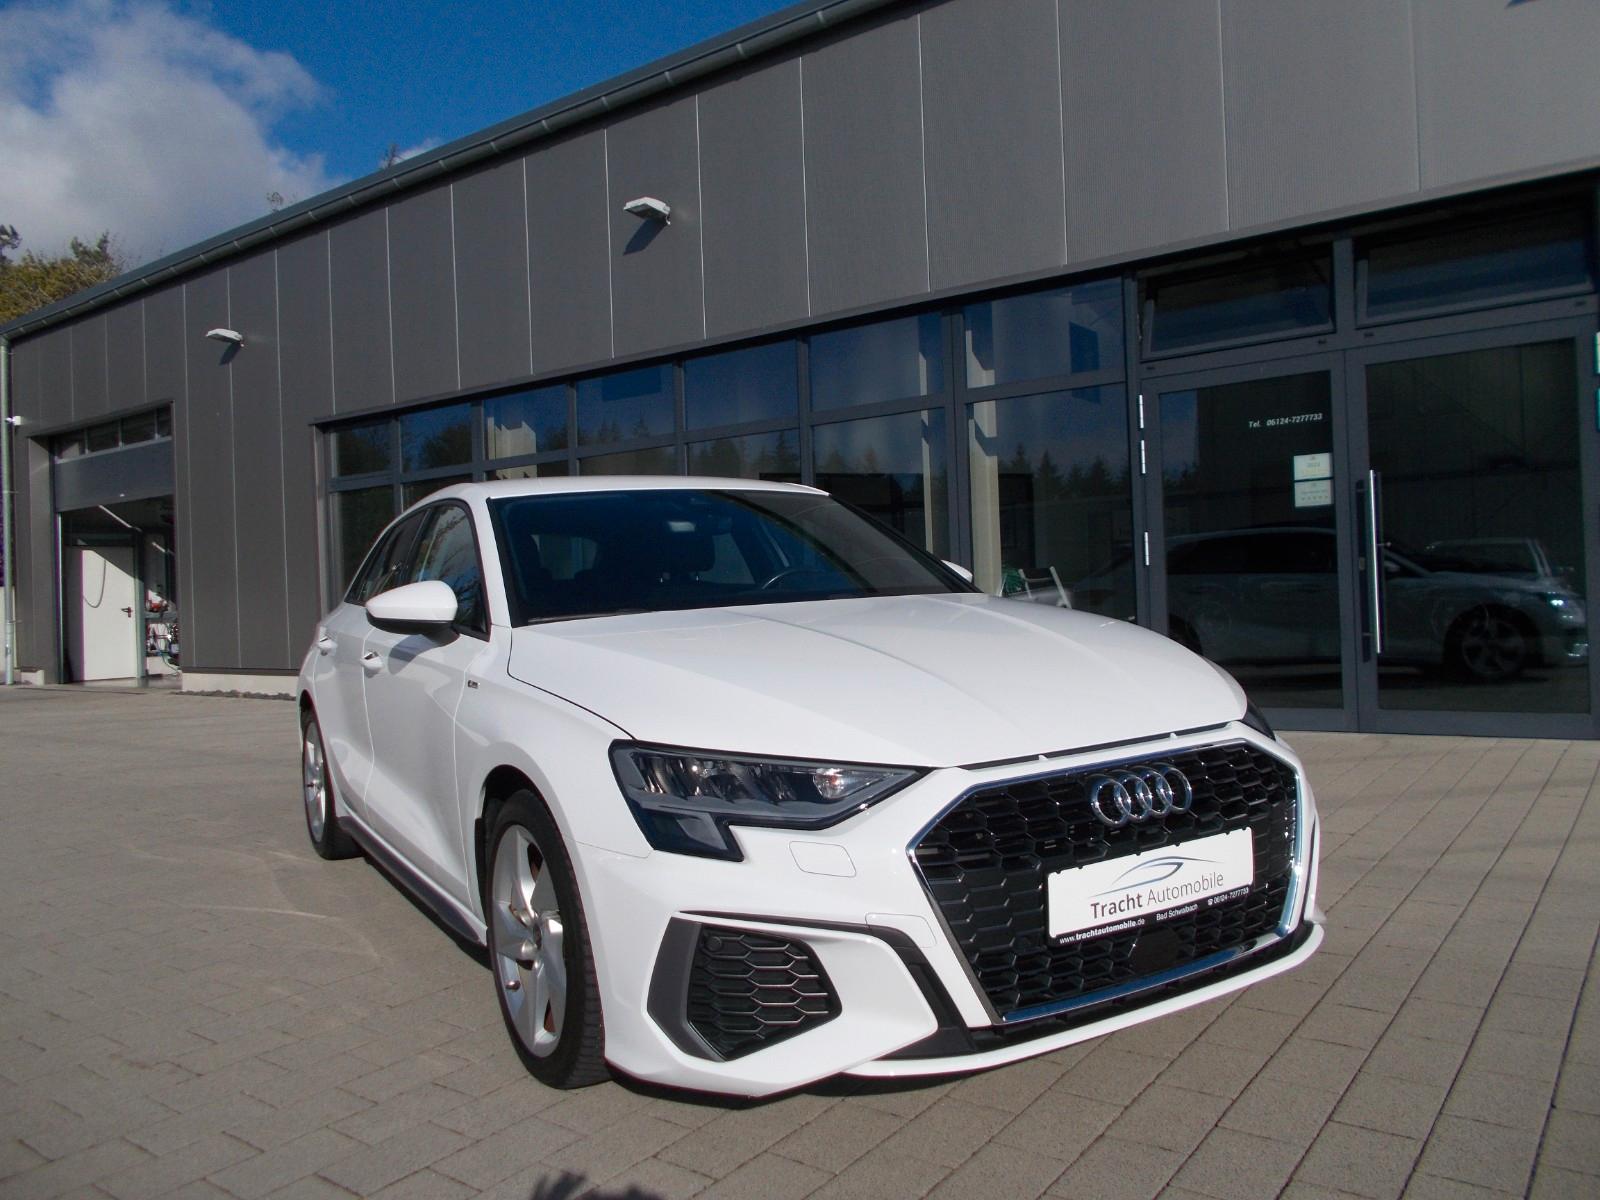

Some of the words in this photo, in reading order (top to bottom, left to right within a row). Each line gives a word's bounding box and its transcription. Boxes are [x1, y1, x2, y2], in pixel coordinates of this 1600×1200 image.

[1090, 892, 1143, 919] Tracht
[1147, 871, 1224, 906] Automobile
[1059, 918, 1145, 944] www.trachtautomobile.de
[1156, 911, 1168, 921] Bad
